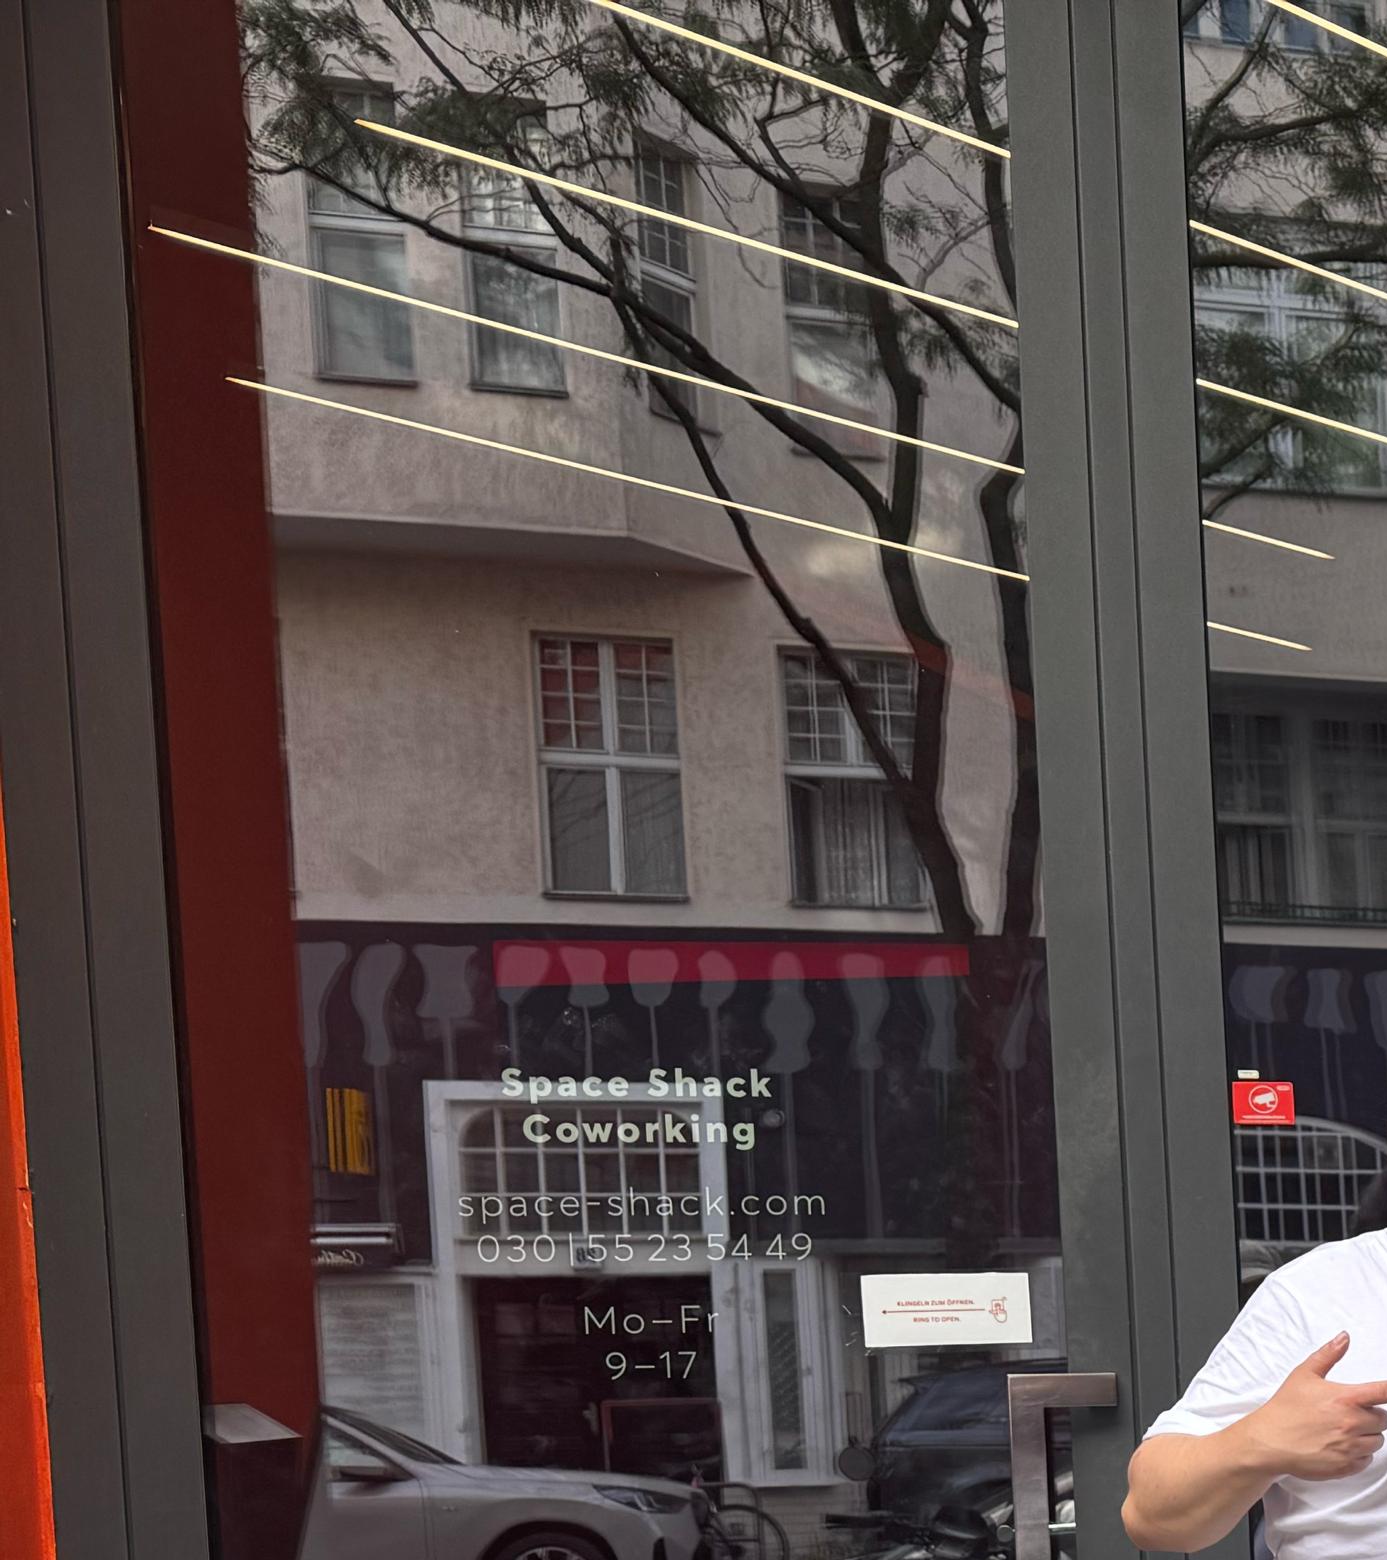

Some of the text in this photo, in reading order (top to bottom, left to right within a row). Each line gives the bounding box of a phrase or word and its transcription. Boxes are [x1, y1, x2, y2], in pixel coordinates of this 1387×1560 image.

[501, 1066, 773, 1104] Space Shack
[521, 1113, 756, 1150] Coworking
[457, 1186, 827, 1224] space-shack.com
[646, 1234, 693, 1263] 23
[705, 1233, 752, 1261] 54
[764, 1232, 813, 1261] 49
